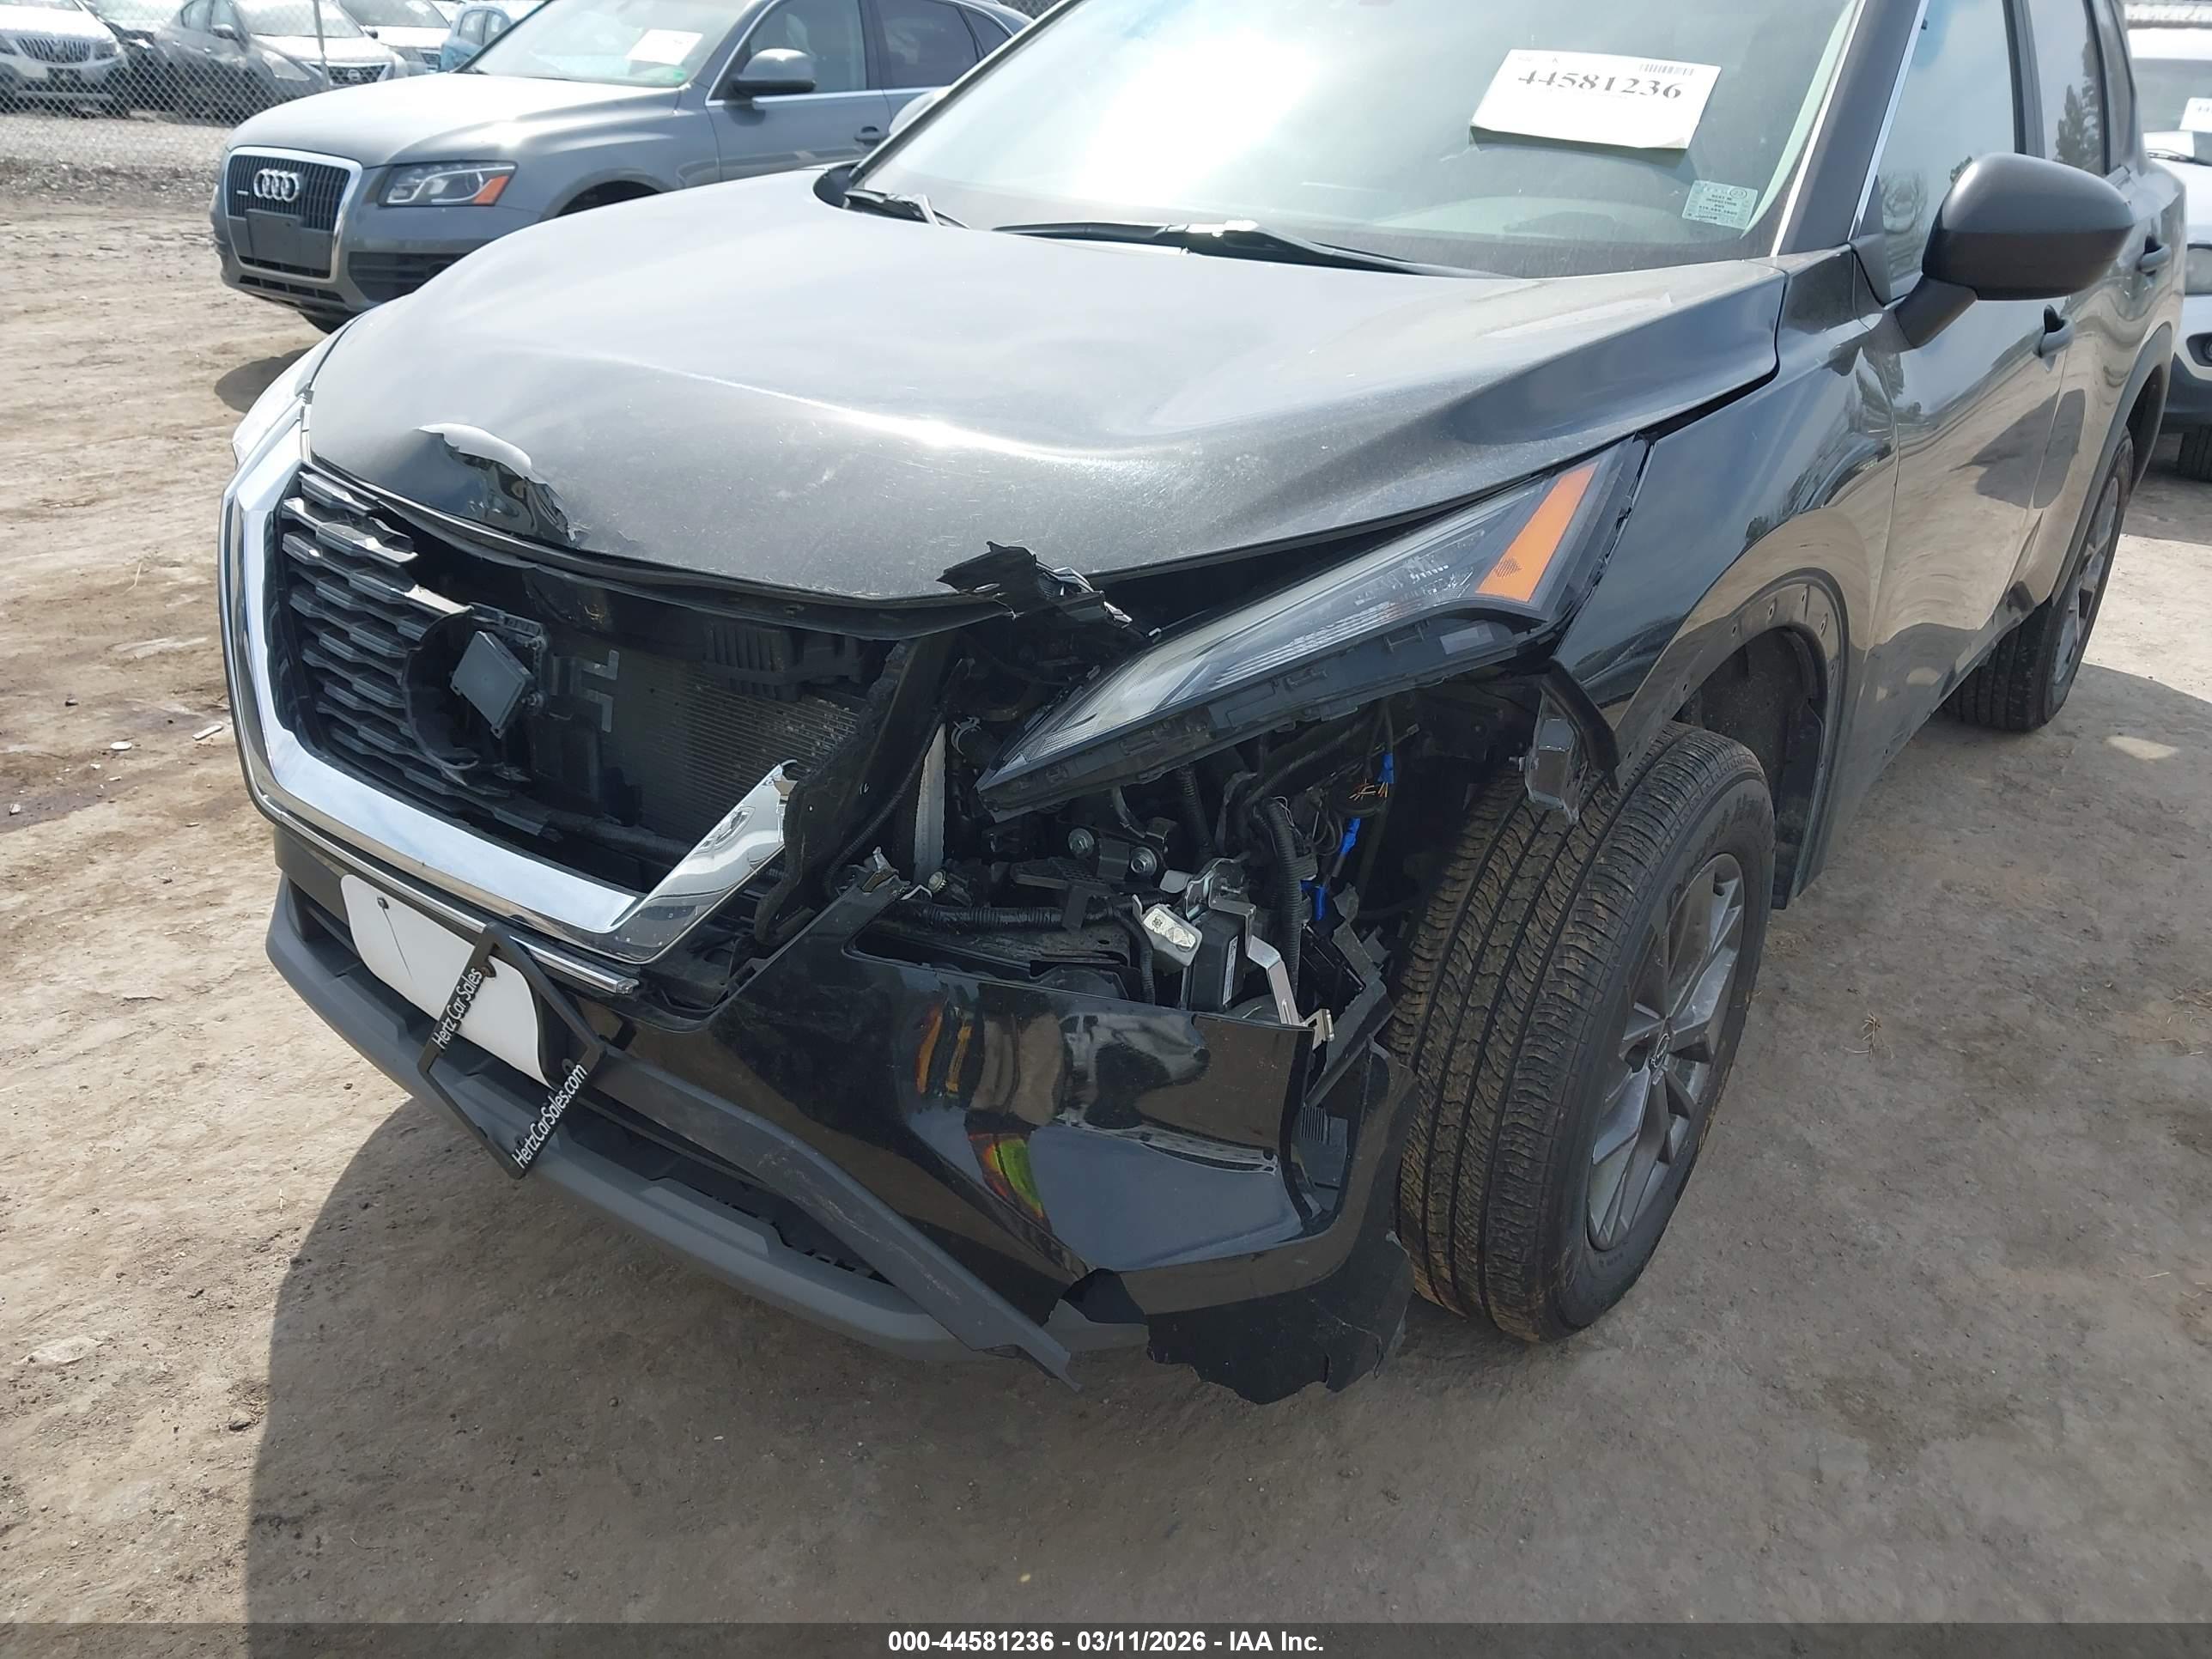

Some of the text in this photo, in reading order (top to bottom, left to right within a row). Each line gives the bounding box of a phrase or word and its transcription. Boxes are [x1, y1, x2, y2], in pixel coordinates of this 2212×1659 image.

[1518, 69, 1683, 100] 44581236
[432, 968, 482, 1049] Hertz Car Sales
[511, 1064, 588, 1169] HertzCarSales.com
